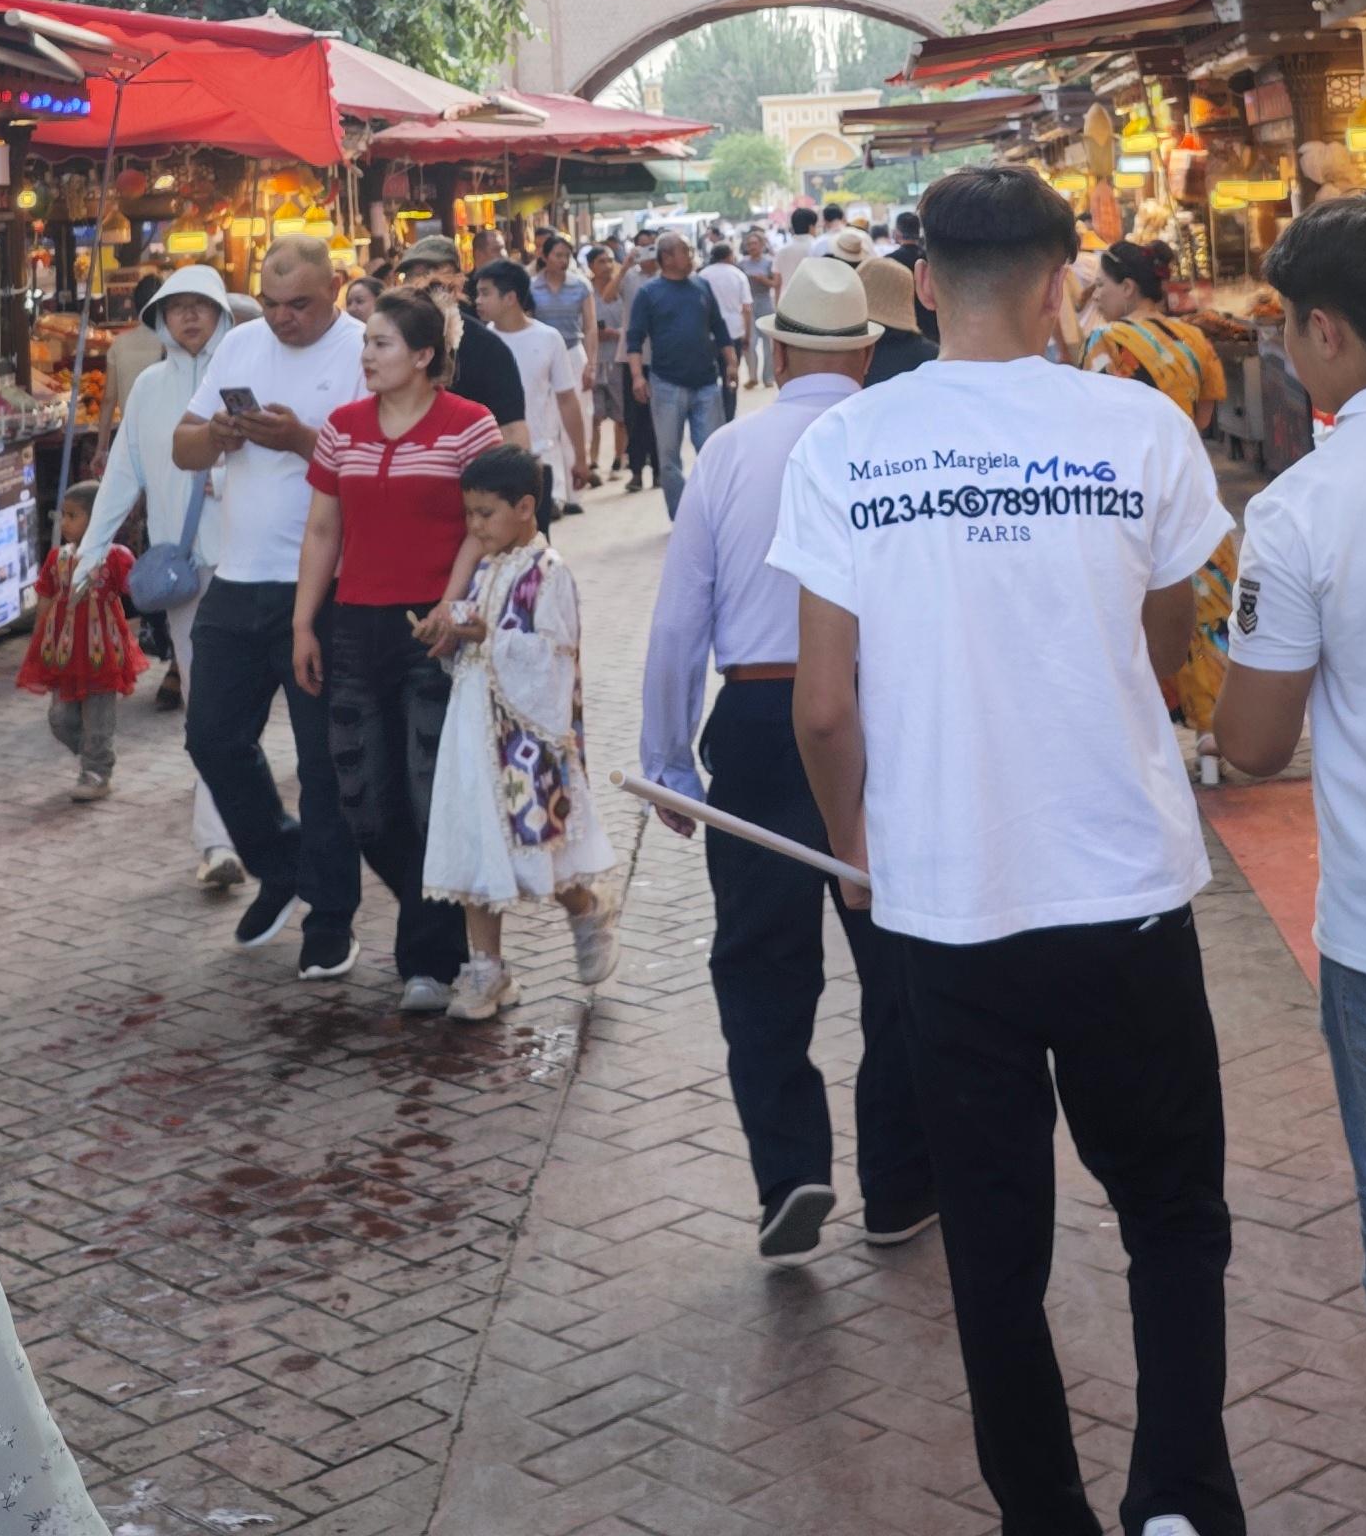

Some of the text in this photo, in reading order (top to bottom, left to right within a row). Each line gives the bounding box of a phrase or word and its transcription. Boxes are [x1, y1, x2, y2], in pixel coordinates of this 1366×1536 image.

[848, 452, 927, 481] Maison
[932, 449, 1021, 475] Margiela
[966, 525, 1032, 543] PARIS
